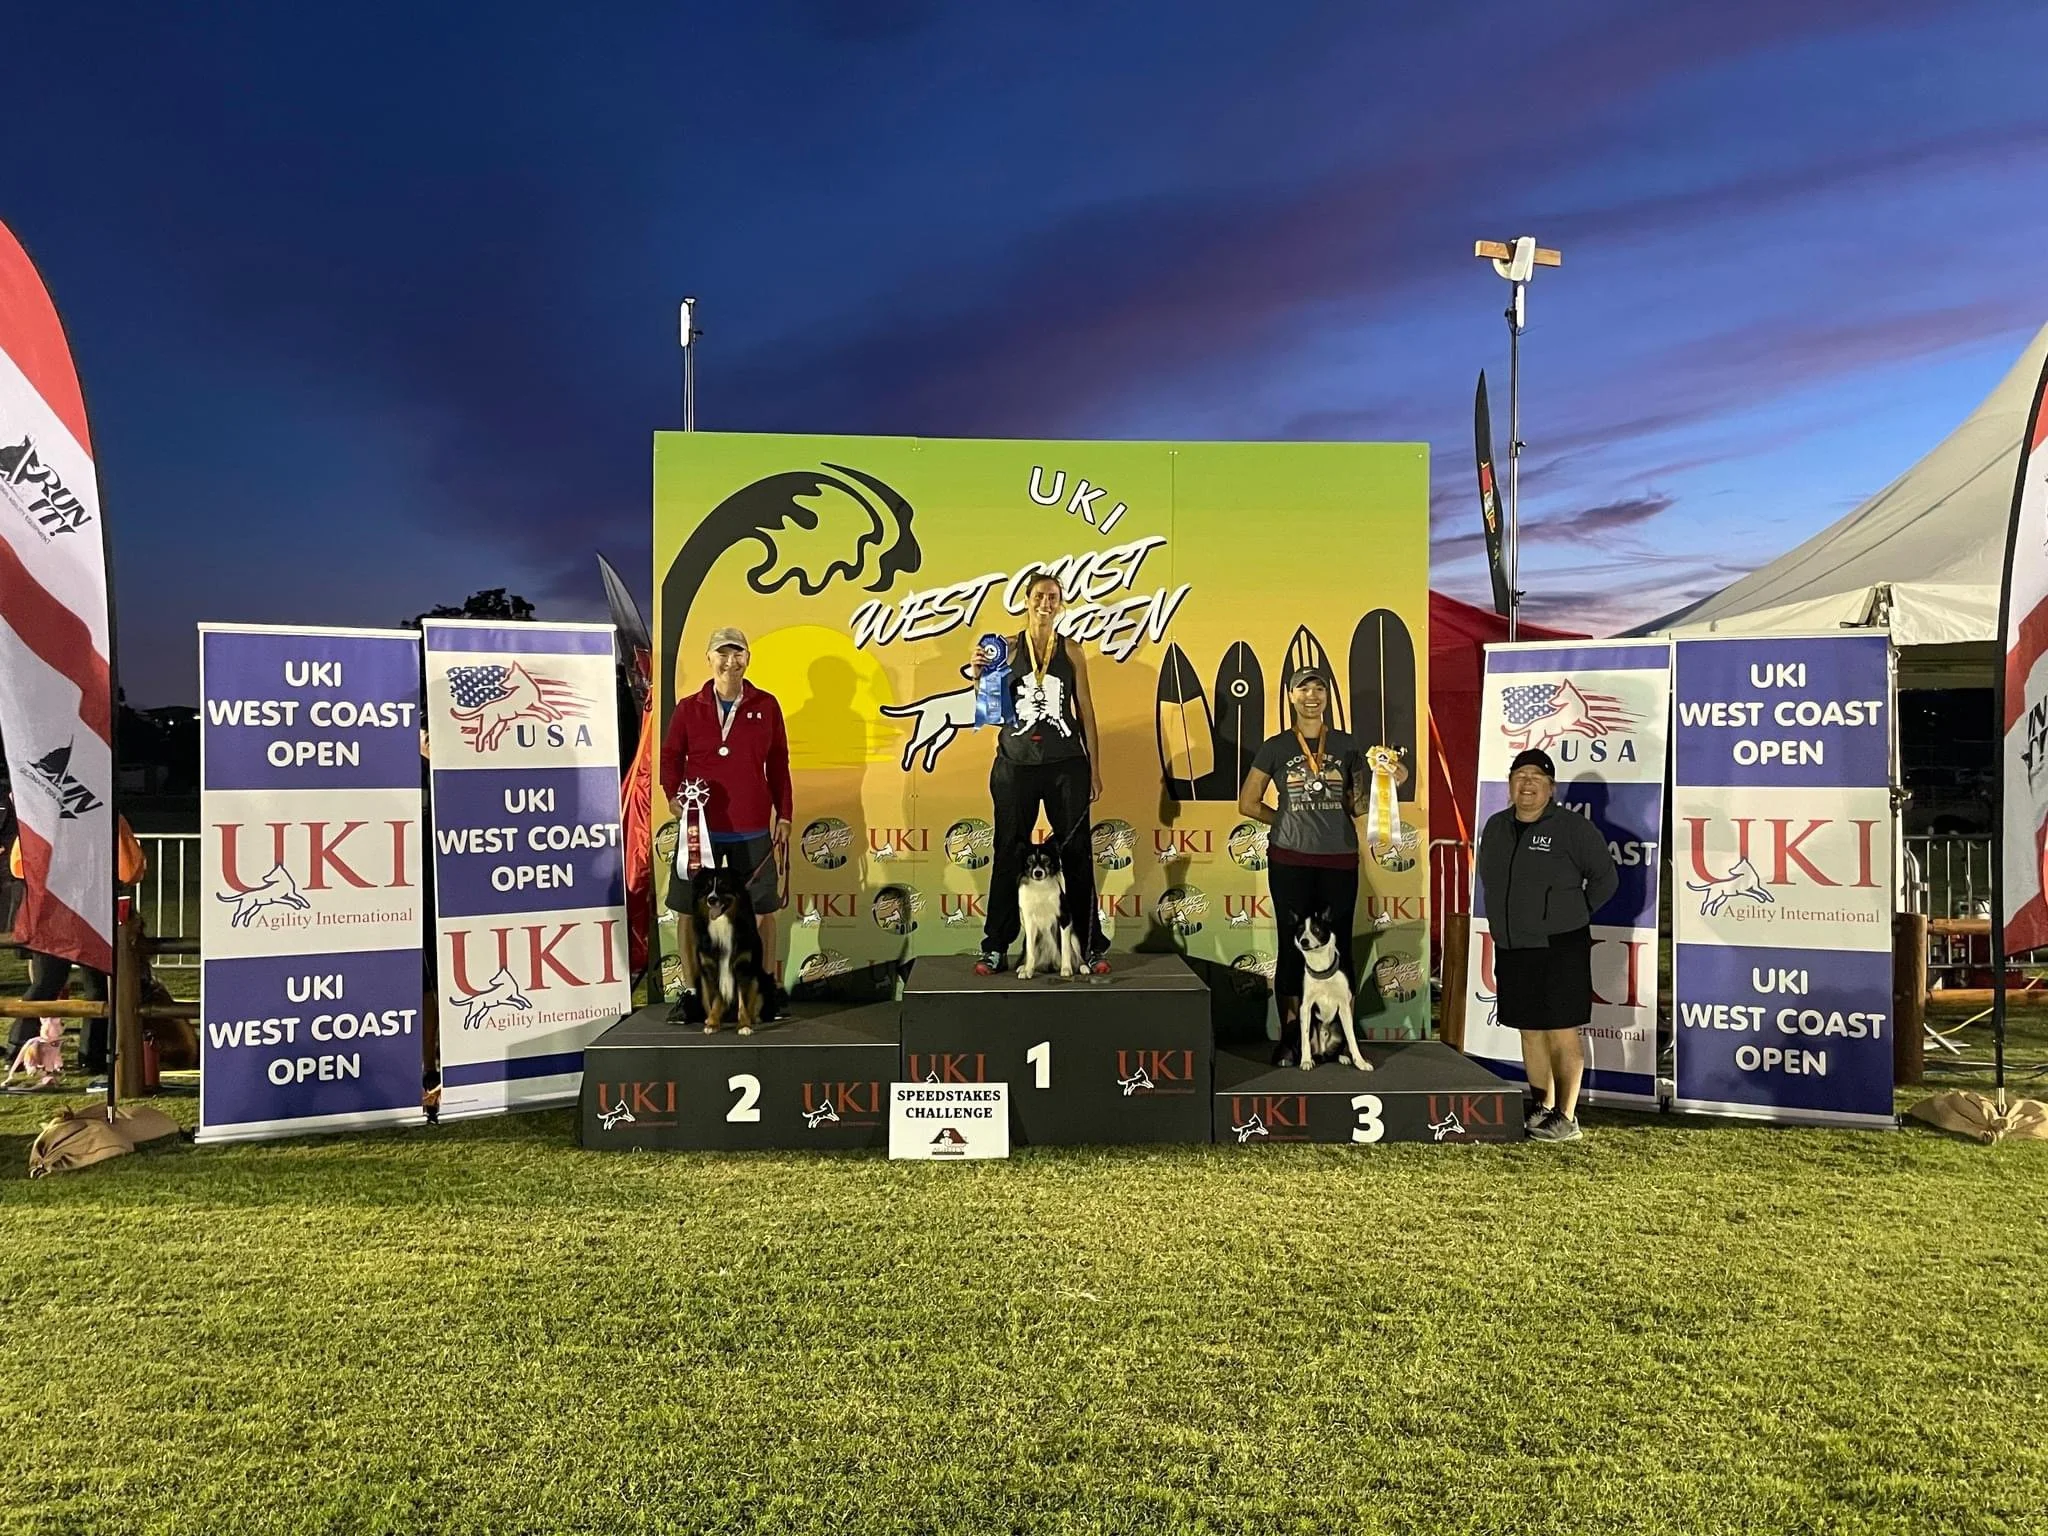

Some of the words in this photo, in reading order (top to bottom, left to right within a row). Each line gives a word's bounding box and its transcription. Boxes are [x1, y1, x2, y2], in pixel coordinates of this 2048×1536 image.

[1028, 465, 1127, 536] UKI
[848, 572, 1009, 650] WEST
[285, 661, 342, 687] UKI
[1751, 663, 1806, 689] UKI
[208, 701, 300, 728] WEST
[310, 701, 416, 728] COAST
[1679, 702, 1765, 727] WEST
[1774, 701, 1883, 728] COAST
[516, 724, 592, 748] USA
[267, 741, 360, 767] OPEN
[1560, 739, 1637, 763] USA
[1733, 739, 1824, 766] OPEN
[505, 788, 555, 814] UKI
[437, 828, 519, 855] WEST
[528, 823, 619, 851] COAST
[869, 828, 929, 853] UKI
[1153, 829, 1213, 853] UKI
[1532, 835, 1552, 844] UKI
[212, 819, 415, 893] UKI
[1607, 841, 1658, 867] AST
[1682, 817, 1882, 889] UKI
[492, 863, 574, 891] OPEN
[255, 909, 312, 930] Agility
[317, 907, 412, 925] International
[796, 893, 857, 918] UKI
[940, 893, 987, 917] UK
[1098, 894, 1143, 917] KI
[1224, 895, 1272, 919] UK
[1367, 896, 1428, 920] UKI
[1723, 904, 1776, 925] Agility
[1781, 907, 1880, 925] International
[443, 920, 623, 998] UKI
[287, 974, 343, 1002] UKI
[1752, 968, 1808, 994] UKI
[208, 1017, 300, 1049] WEST
[311, 1010, 417, 1041] COAST
[485, 1011, 534, 1032] Agility
[538, 1003, 623, 1024] International
[1680, 1003, 1766, 1032] WEST
[1776, 1009, 1886, 1039] COAST
[267, 1053, 360, 1086] OPEN
[908, 1052, 987, 1083] UKI
[1026, 1040, 1052, 1090] 1
[1116, 1049, 1196, 1081] UKI
[1735, 1045, 1827, 1076] OPEN
[597, 1081, 678, 1114] UKI
[726, 1073, 762, 1124] 2
[802, 1081, 881, 1114] UKI
[897, 1090, 1001, 1102] SPEEDSTAKES
[905, 1107, 993, 1119] CHALLENGE
[1232, 1095, 1309, 1127] UKI
[1350, 1094, 1386, 1144] 3
[1428, 1095, 1505, 1127] UKI
